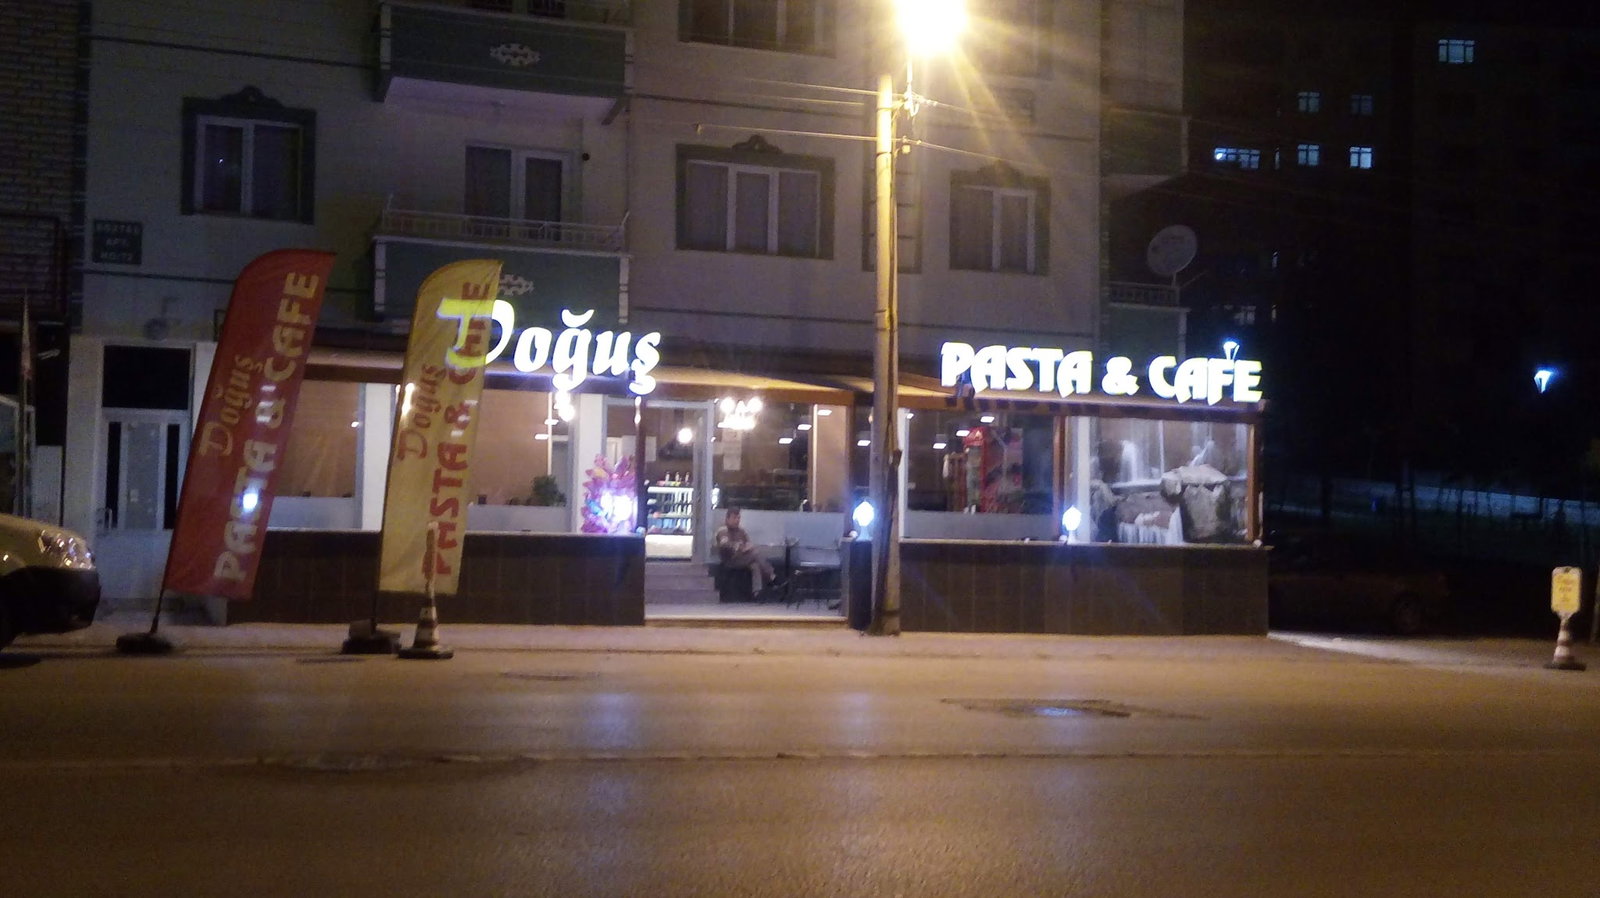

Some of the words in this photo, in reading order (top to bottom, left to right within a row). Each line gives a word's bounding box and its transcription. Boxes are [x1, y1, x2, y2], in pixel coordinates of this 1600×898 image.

[264, 271, 320, 383] CAFE
[436, 298, 662, 395] Doğuş
[941, 341, 1095, 398] PASTA
[1102, 356, 1140, 395] &
[1149, 356, 1264, 406] CAFE
